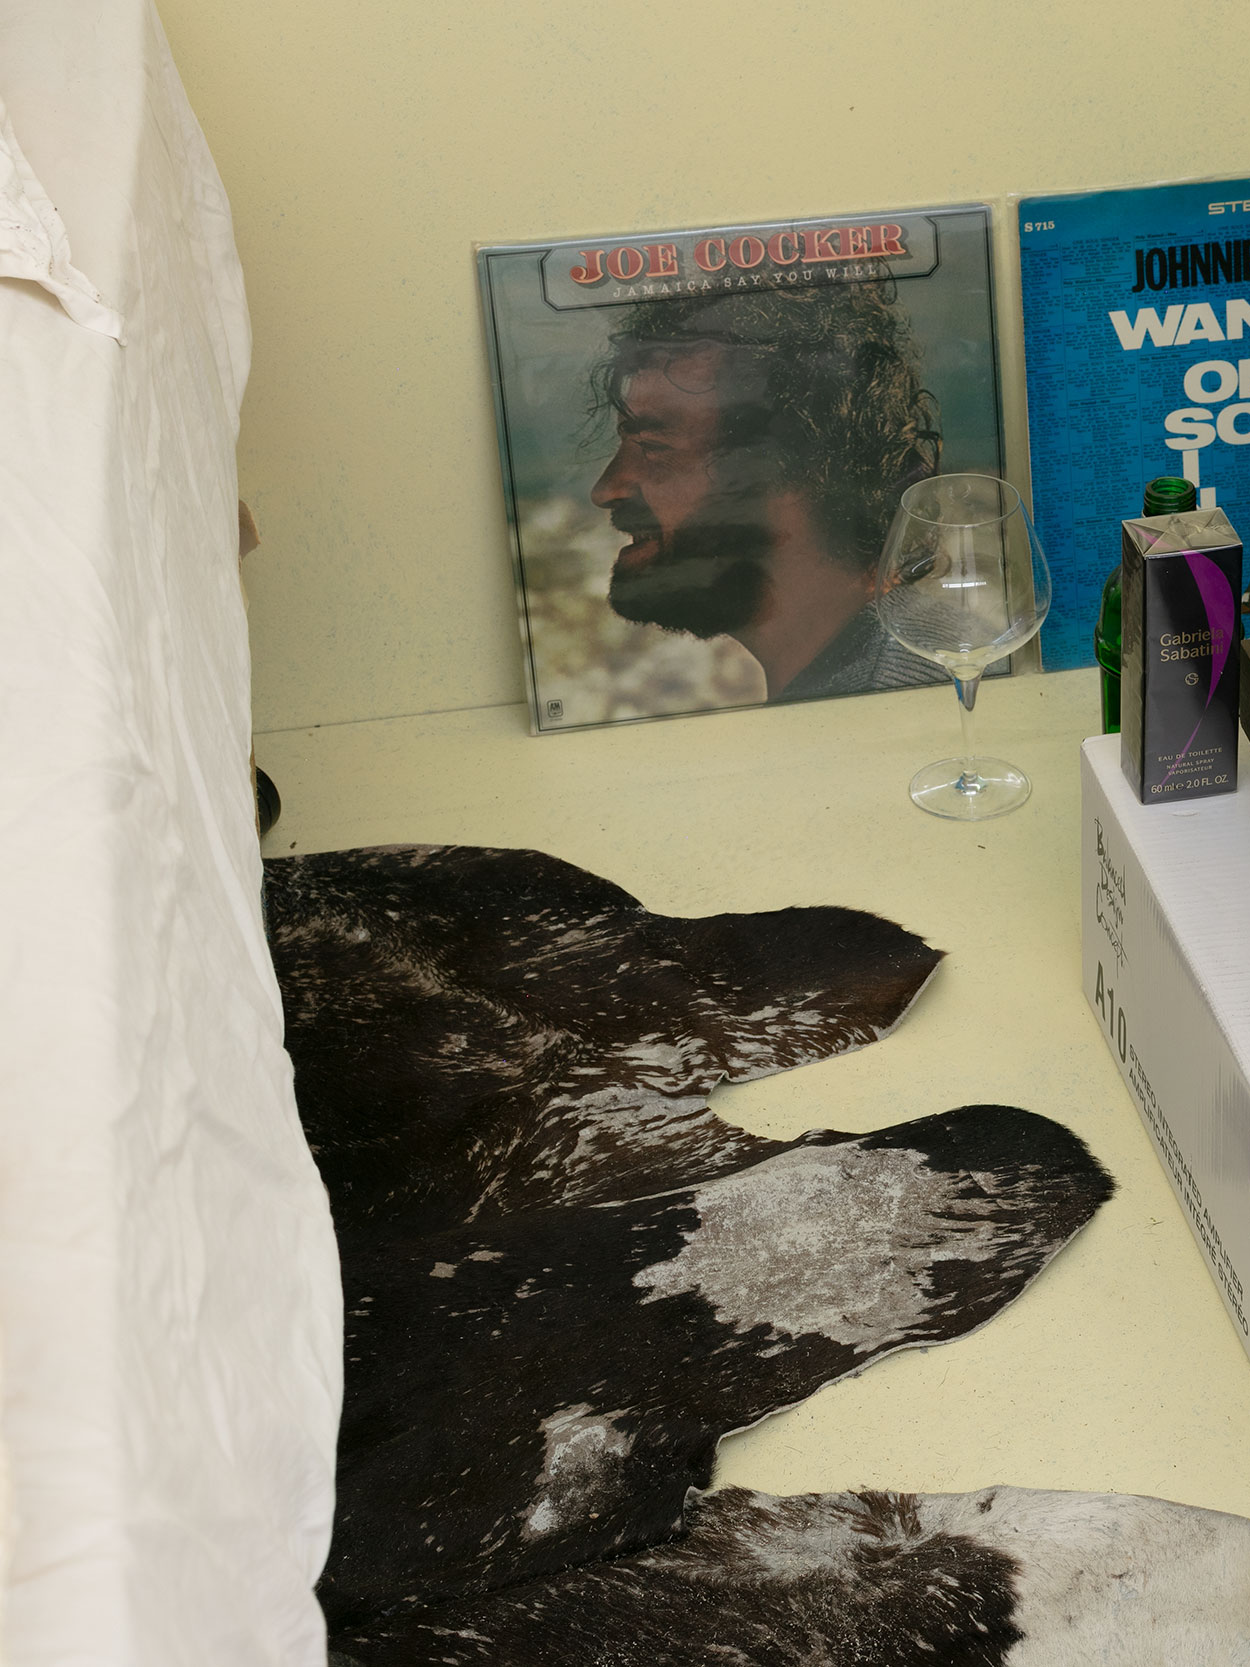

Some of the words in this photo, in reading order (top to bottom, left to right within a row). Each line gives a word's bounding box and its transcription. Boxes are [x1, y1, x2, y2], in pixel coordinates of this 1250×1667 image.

[1024, 222, 1034, 232] S
[1035, 220, 1055, 231] 715
[570, 243, 678, 284] JOE
[694, 224, 906, 271] COCKER
[613, 279, 712, 298] JAMAICA
[724, 274, 761, 288] SAY
[773, 269, 813, 283] YOU
[826, 264, 877, 279] WILL
[1160, 627, 1224, 647] Gabriela
[1160, 642, 1224, 662] Sabatini
[1188, 747, 1223, 758] TOILETTE
[1195, 757, 1215, 765] SPRAY
[1151, 784, 1163, 793] 60
[1164, 781, 1175, 792] ml
[1186, 779, 1200, 789] 2.0
[1094, 960, 1127, 1063] A10
[1128, 1067, 1183, 1192] AMPLIFICATEUR
[1129, 1044, 1156, 1108] STEREO
[1157, 1104, 1202, 1207] INTEGRATED
[1203, 1207, 1244, 1301] AMPLIFIER
